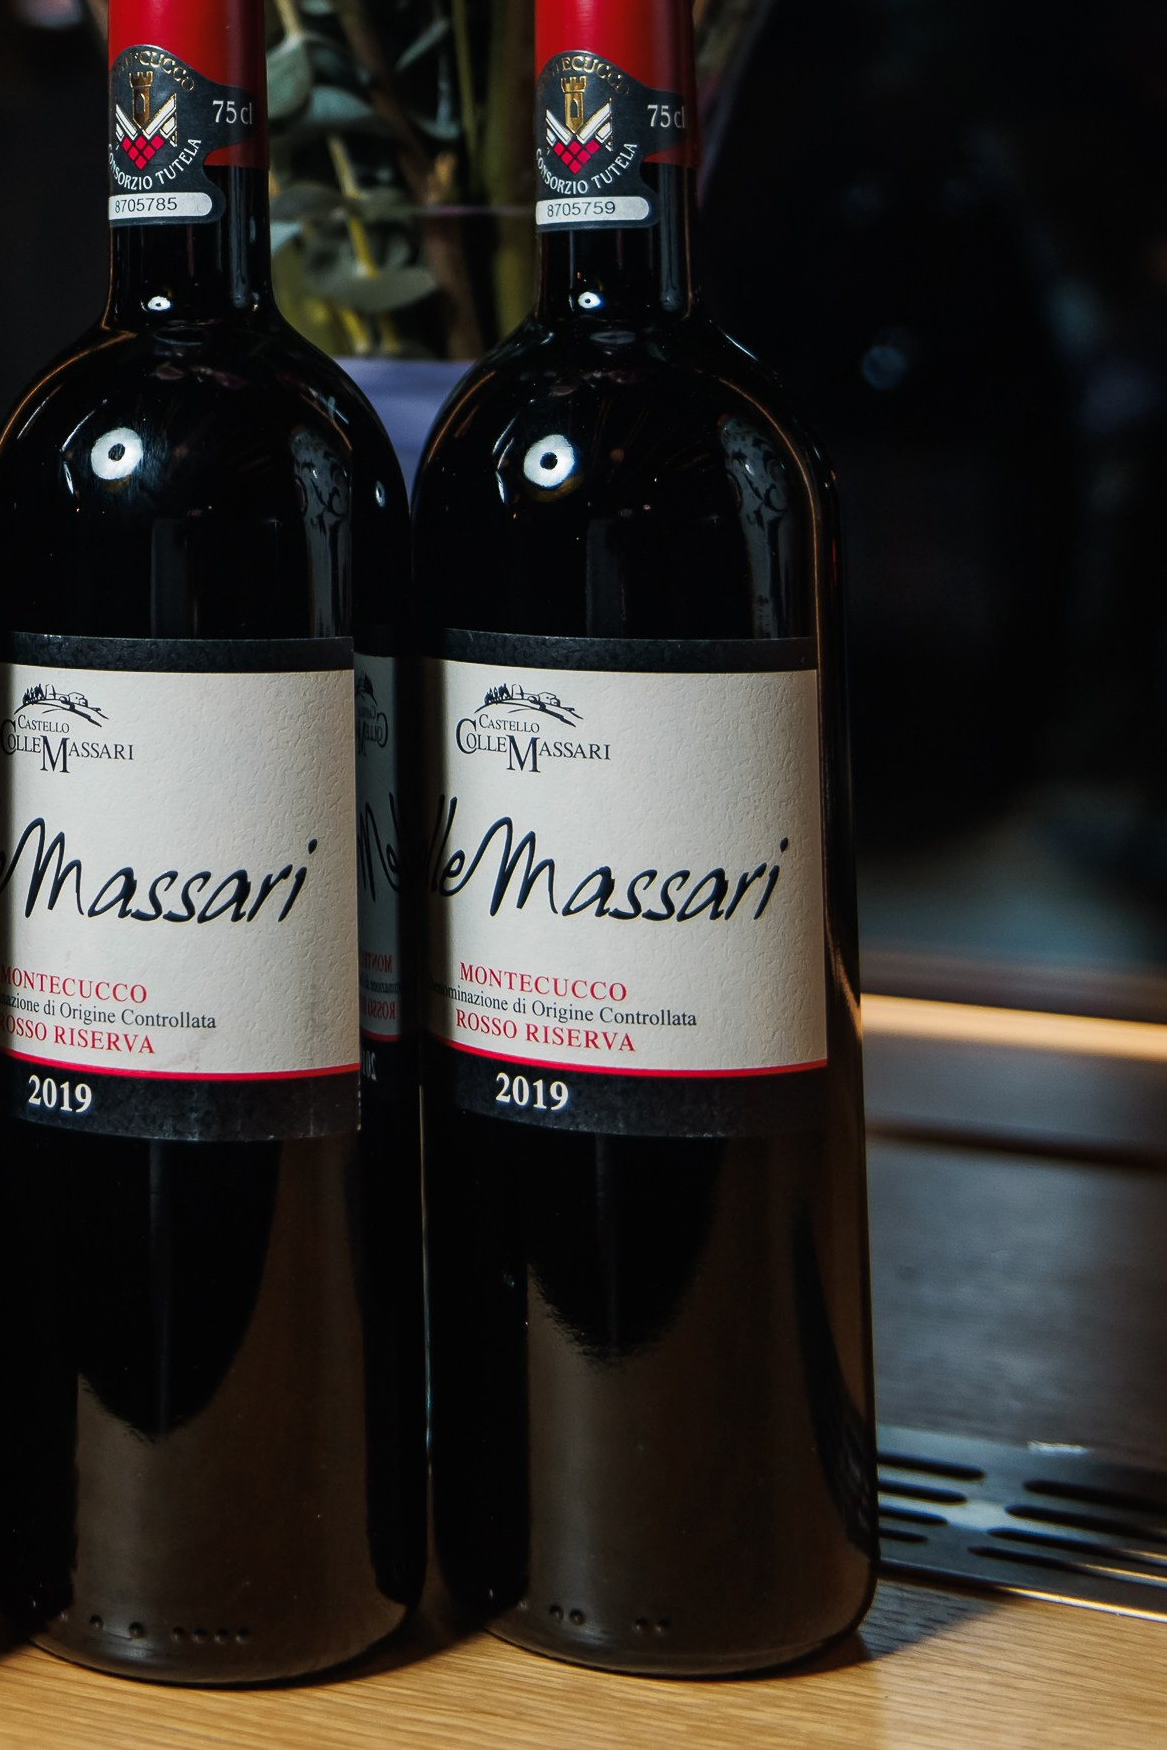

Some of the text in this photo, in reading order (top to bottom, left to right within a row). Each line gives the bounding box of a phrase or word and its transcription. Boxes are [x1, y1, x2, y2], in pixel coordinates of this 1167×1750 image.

[155, 139, 202, 184] TUTELA
[536, 143, 637, 194] CONSORZIO TUTELA
[114, 196, 179, 214] 8705785
[547, 200, 616, 218] 8705759
[17, 714, 70, 734] CASTELLO
[479, 714, 540, 733] CASTELLO
[1, 964, 147, 1004] MONTECUCCO
[460, 962, 627, 1002] MONTECUCCO
[43, 999, 55, 1016] di
[60, 1002, 116, 1025] Origine
[121, 1008, 216, 1029] Controllata
[512, 996, 526, 1014] di
[531, 1000, 594, 1024] Origine
[599, 1007, 697, 1027] Controllata
[53, 1025, 155, 1054] RISERVA
[455, 1008, 635, 1052] ROSSO RISERVA
[27, 1074, 93, 1113] 2019
[495, 1072, 569, 1111] 2019
